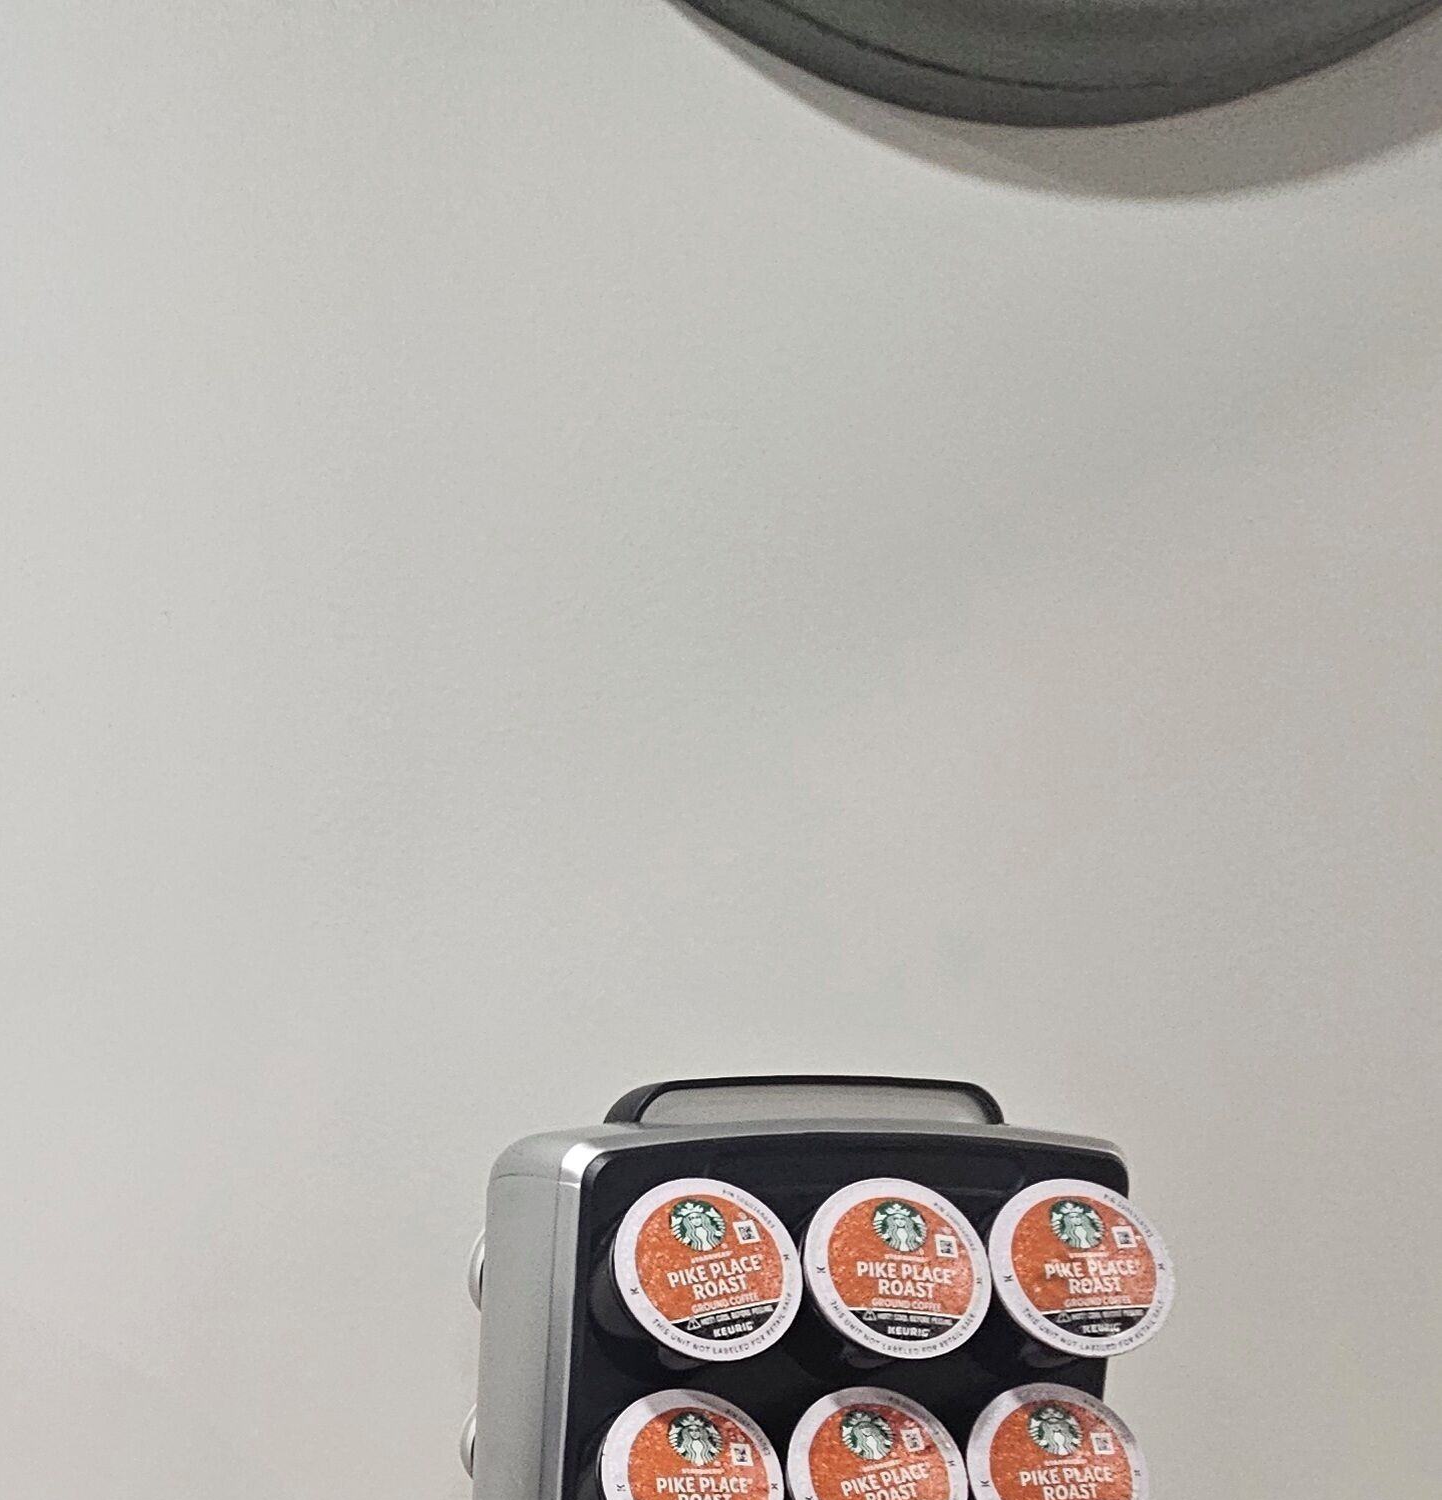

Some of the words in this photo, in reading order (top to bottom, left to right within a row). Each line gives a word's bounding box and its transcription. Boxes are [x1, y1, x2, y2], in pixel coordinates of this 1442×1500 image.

[667, 1266, 708, 1289] PIKE
[857, 1261, 897, 1279] PIKE
[1044, 1261, 1083, 1279] PIKE
[693, 1275, 747, 1300] ROAST
[878, 1279, 935, 1298] ROAST
[1069, 1277, 1122, 1294] ROAST
[656, 1477, 695, 1493] PIKE
[840, 1475, 878, 1496] PIKE
[1019, 1470, 1058, 1486] PIKE
[1043, 1483, 1098, 1500] ROAST
